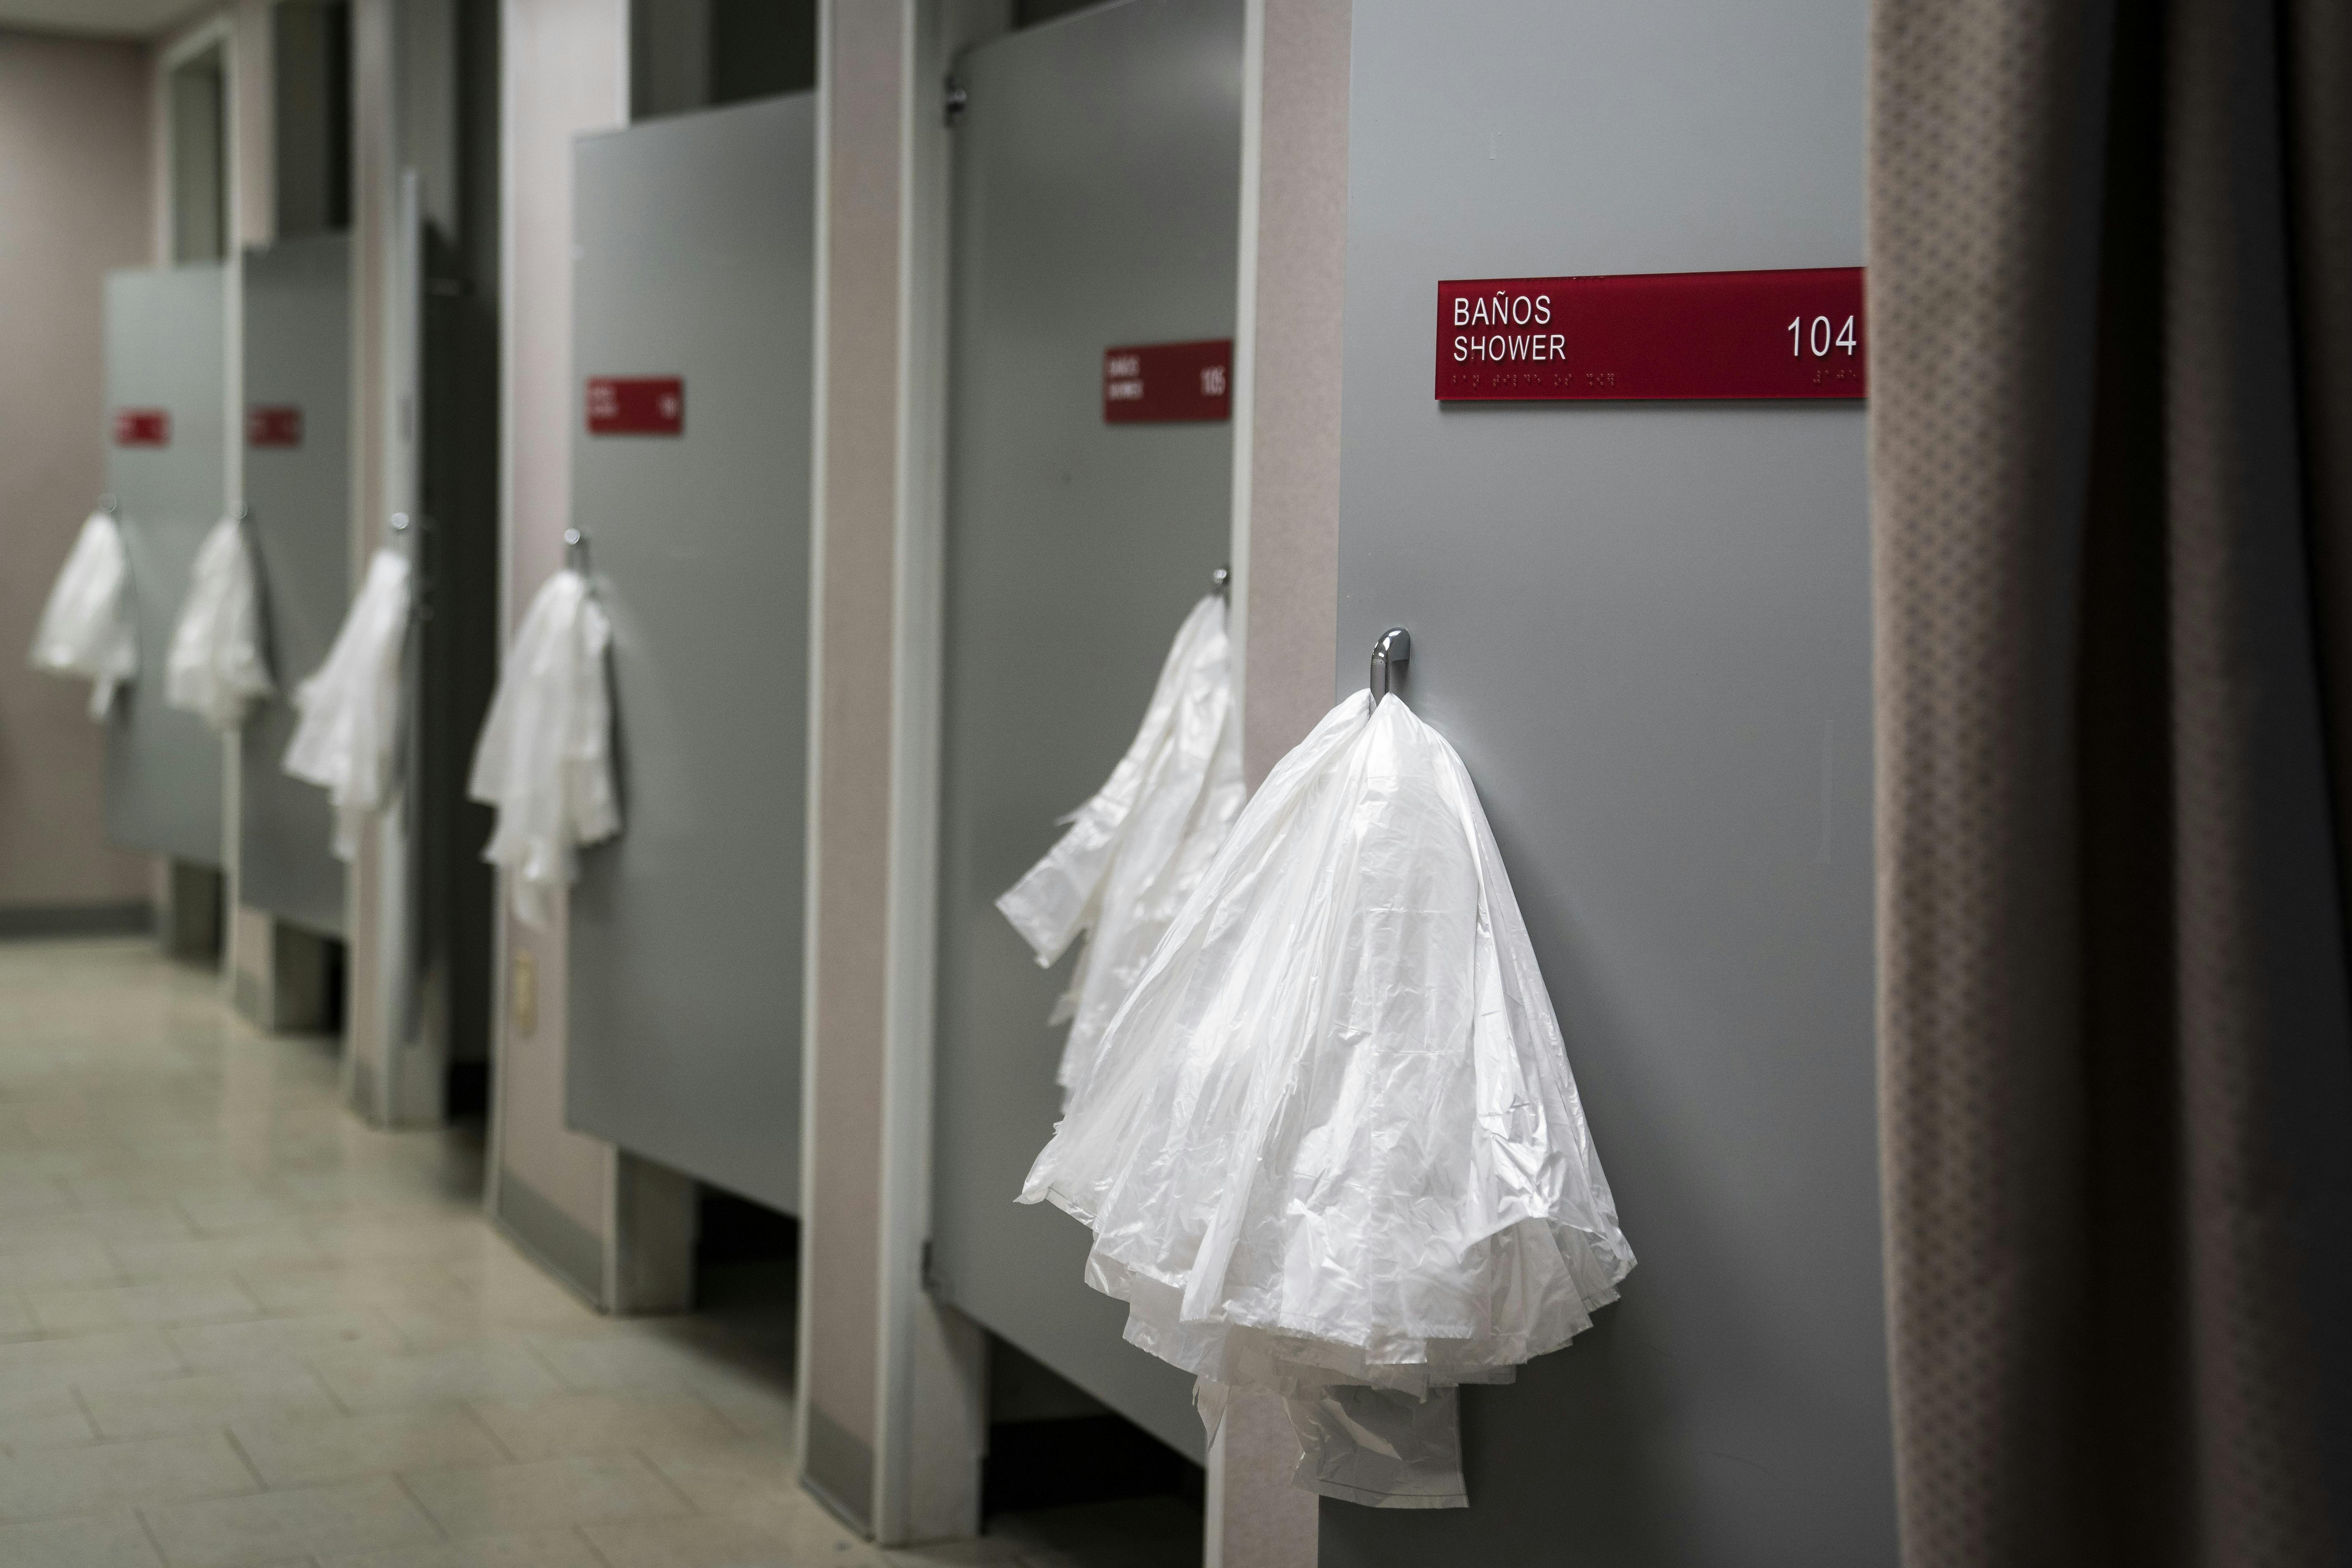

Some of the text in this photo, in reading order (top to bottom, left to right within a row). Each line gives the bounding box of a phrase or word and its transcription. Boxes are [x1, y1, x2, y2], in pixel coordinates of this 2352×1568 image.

[1454, 291, 1551, 326] BAÑOS
[1454, 334, 1566, 361] SHOWER
[1788, 315, 1857, 356] 104
